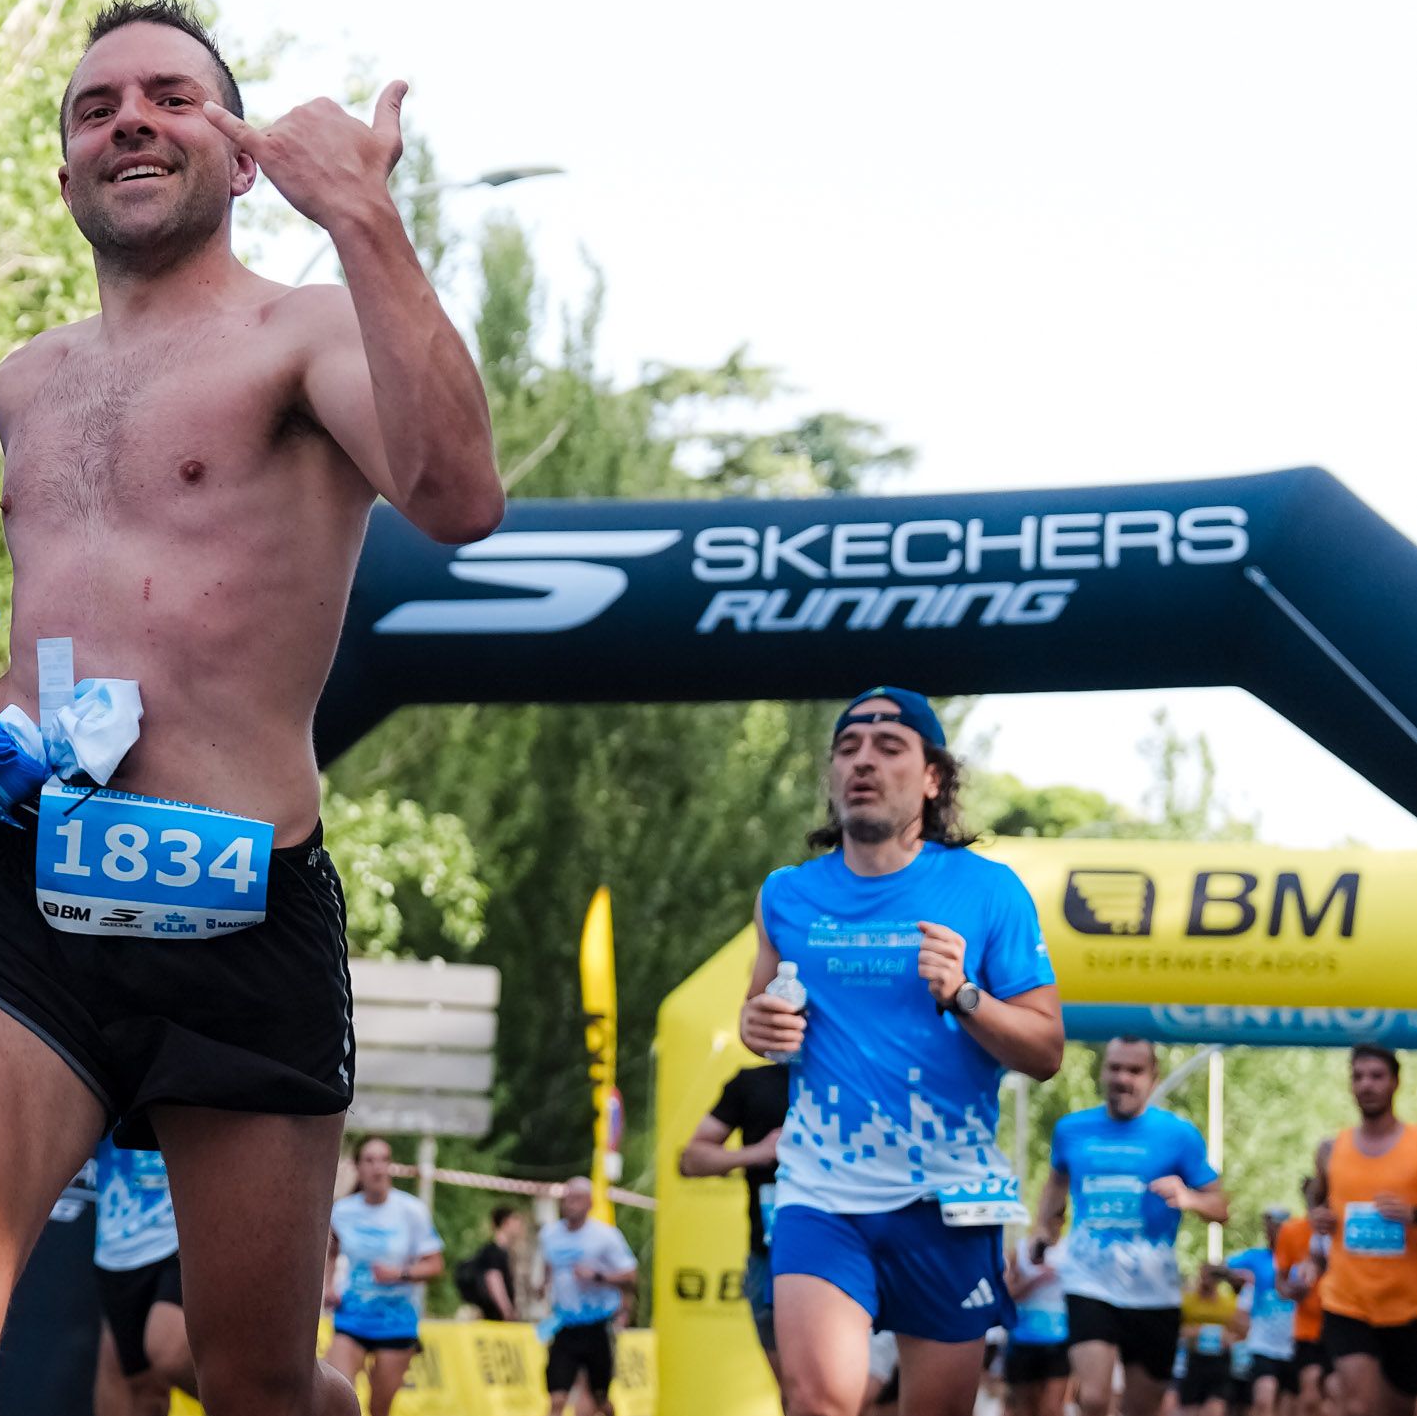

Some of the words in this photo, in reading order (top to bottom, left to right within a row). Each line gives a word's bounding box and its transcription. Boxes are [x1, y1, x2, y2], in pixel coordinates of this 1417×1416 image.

[692, 504, 1249, 582] SKECHERS
[696, 579, 1079, 634] RUNNING
[53, 819, 258, 894] 1834
[60, 905, 91, 922] BM
[1185, 871, 1361, 938] BM
[153, 921, 197, 933] KLM
[827, 957, 863, 975] Run
[868, 957, 907, 975] Well
[1084, 950, 1341, 973] SUPERMERCADOS
